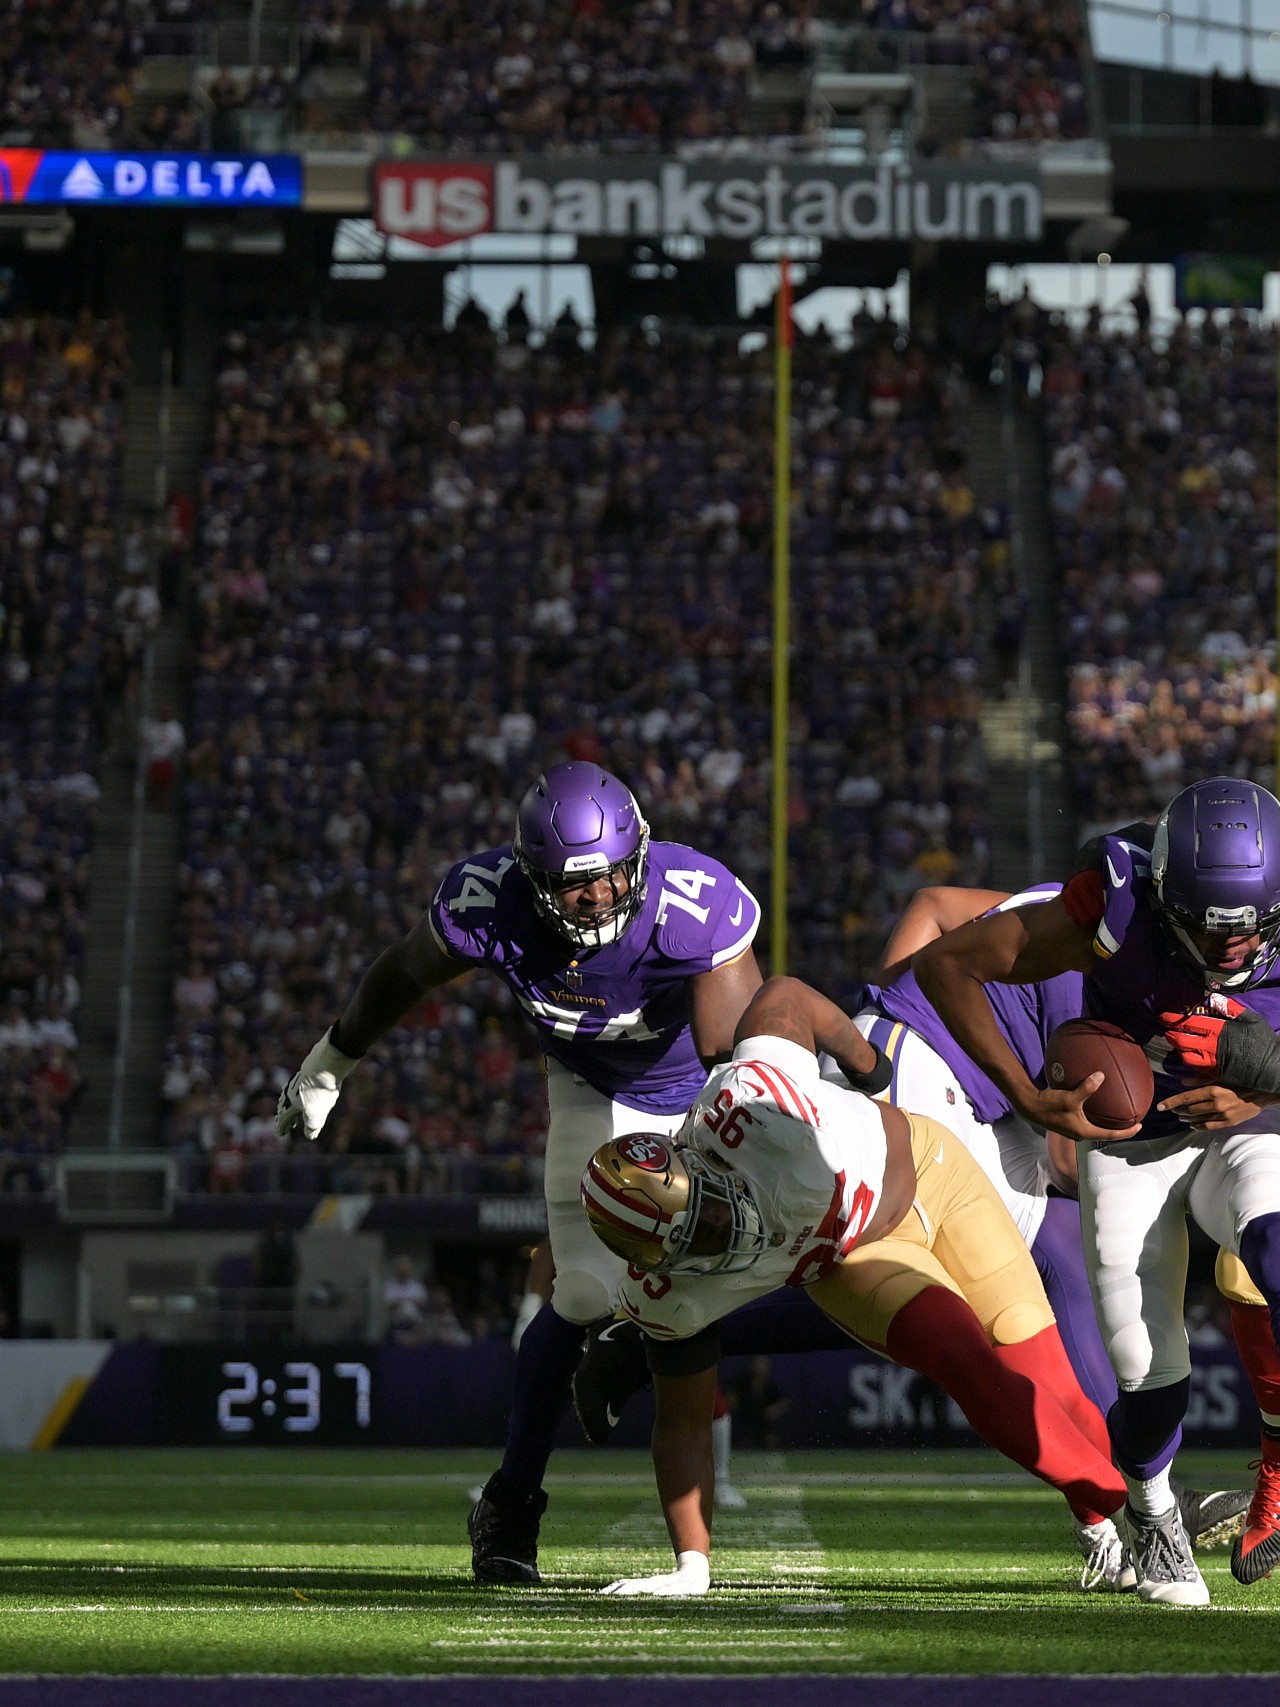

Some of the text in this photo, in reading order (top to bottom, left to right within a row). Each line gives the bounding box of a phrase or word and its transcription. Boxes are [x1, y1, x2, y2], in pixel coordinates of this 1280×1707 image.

[113, 160, 276, 198] DELTA
[449, 856, 515, 913] 74
[654, 869, 717, 925] 74
[703, 1088, 753, 1149] 95
[217, 1362, 371, 1431] 2:37
